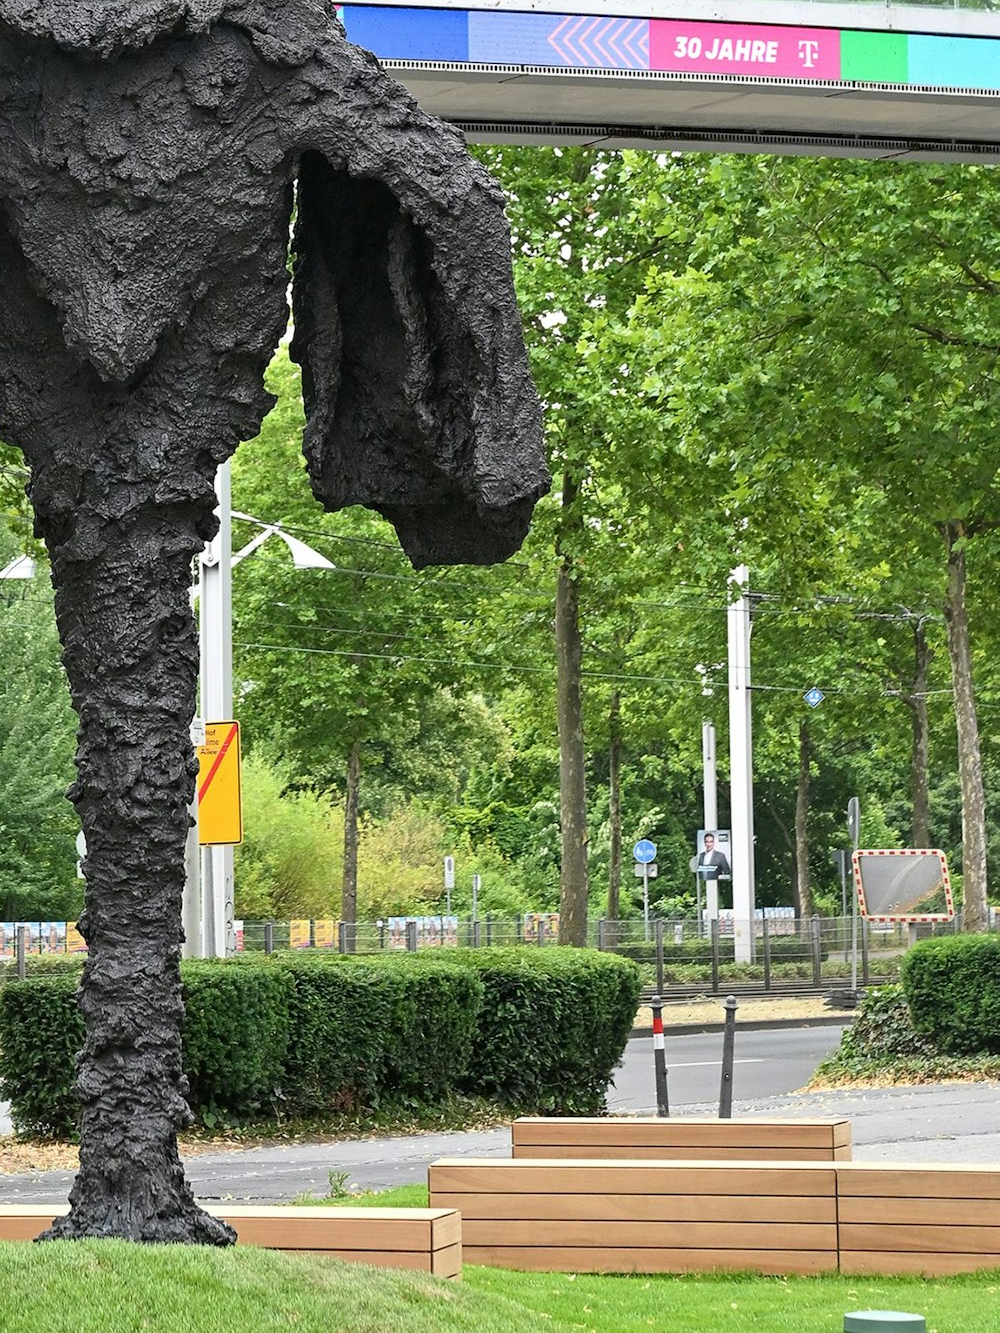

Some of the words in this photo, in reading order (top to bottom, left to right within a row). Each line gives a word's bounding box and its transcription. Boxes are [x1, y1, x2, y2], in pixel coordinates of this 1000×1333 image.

[673, 36, 703, 60] 30
[704, 38, 779, 63] JAHRE
[798, 40, 819, 68] T
